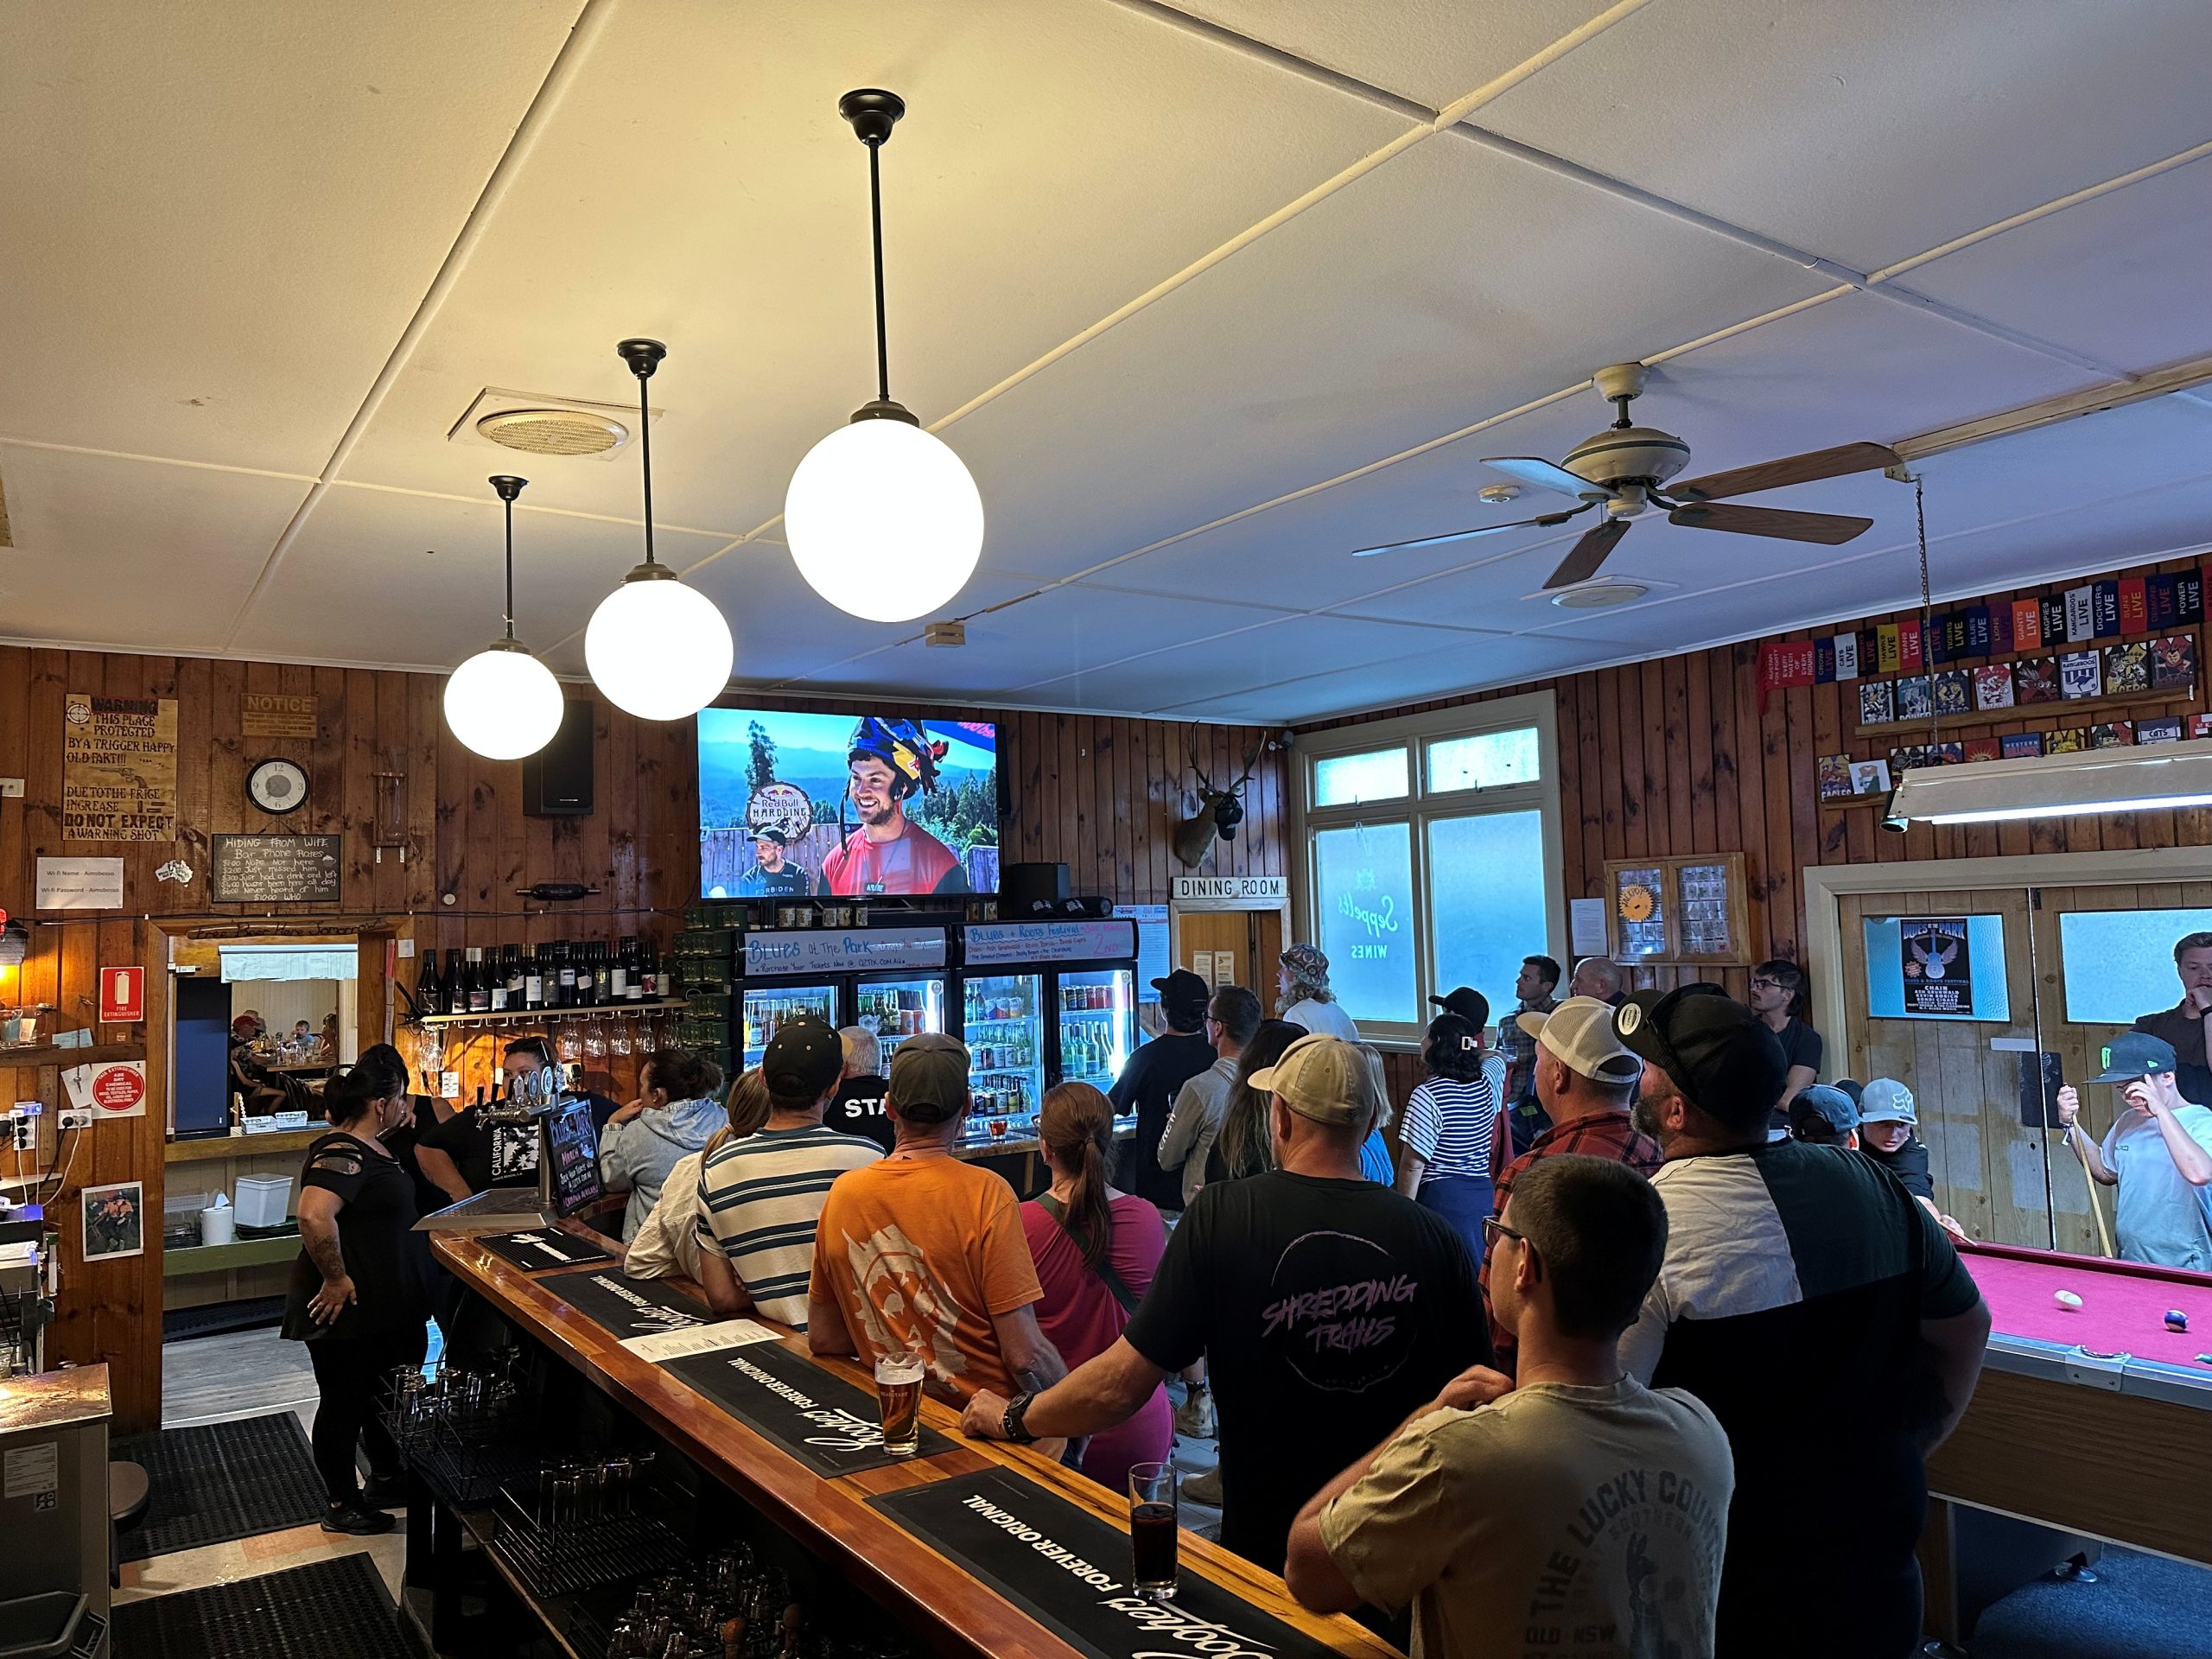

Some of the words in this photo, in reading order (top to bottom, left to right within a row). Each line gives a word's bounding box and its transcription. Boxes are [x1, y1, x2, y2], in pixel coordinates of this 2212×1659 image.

[2132, 591, 2143, 618] LIVE
[2161, 588, 2171, 614] LIVE
[2177, 582, 2186, 614] POWER
[2188, 582, 2199, 609] LIVE
[2051, 605, 2063, 631] LIVE
[2069, 593, 2077, 636] KANGAROOS
[2078, 599, 2089, 626] LIVE
[2105, 594, 2116, 621] LIVE
[1978, 617, 1987, 643] LIVE
[2026, 611, 2037, 636] LIVE
[2043, 602, 2051, 638] MAGPIES
[1910, 632, 1918, 655] LIVE
[1931, 626, 1941, 652] LIVE
[1955, 620, 1963, 646] LIVE
[1846, 645, 1854, 668] LIVE
[1866, 639, 1875, 663] LIVE
[1888, 636, 1897, 659] LIVE
[1795, 659, 1799, 671] OF
[1825, 649, 1834, 672] LIVE
[2063, 660, 2095, 669] KANGAROOS
[92, 697, 156, 713] WARNING
[247, 696, 312, 712] NOTICE
[93, 713, 120, 725] THIS
[123, 715, 155, 727] PLACE
[93, 725, 156, 738] PROTECTED
[68, 737, 83, 748] BY
[83, 739, 91, 750] A
[93, 739, 140, 752] TRIGGER
[143, 741, 175, 753] HAPPY
[2005, 739, 2038, 748] WESTERN
[2149, 729, 2168, 738] CATS
[67, 752, 90, 763] OLD
[274, 764, 283, 772] 12
[67, 786, 88, 798] DUE
[89, 787, 104, 798] TO
[103, 787, 127, 799] THE
[130, 788, 160, 800] PRICE
[762, 798, 780, 808] Red
[781, 798, 798, 807] Bull
[66, 799, 119, 812] INCREASE
[64, 813, 85, 828] DO
[86, 814, 116, 828] NOT
[121, 814, 175, 830] EXPECT
[68, 830, 76, 839] A
[77, 829, 128, 840] WARNING
[130, 830, 160, 841] SHOT
[226, 837, 261, 848] HIDING
[270, 838, 296, 847] FROM
[235, 849, 256, 860] Bar
[263, 849, 291, 857] Phone
[296, 849, 324, 858] Rates
[267, 880, 285, 888] been
[1181, 880, 1233, 896] DINING
[1242, 880, 1280, 895] ROOM
[195, 927, 228, 939] Free
[235, 922, 270, 938] Beer
[275, 922, 303, 937] Here
[308, 920, 382, 936] Tomorrow
[1903, 923, 1929, 940] BLUES
[1939, 923, 1967, 940] PARK
[821, 943, 841, 955] The
[845, 1099, 887, 1118] STA
[492, 1127, 502, 1176] CALIFORNIA
[1261, 1274, 1419, 1338] SHREDDING
[728, 1357, 777, 1383] ORIGINAL
[766, 1381, 819, 1408] FOREVER
[962, 1494, 1044, 1543] ORIGINAL
[1529, 1550, 1581, 1618] THE
[1567, 1470, 1646, 1548] LUCKY
[1036, 1538, 1125, 1593] FOREVER
[1096, 1598, 1280, 1659] oopers
